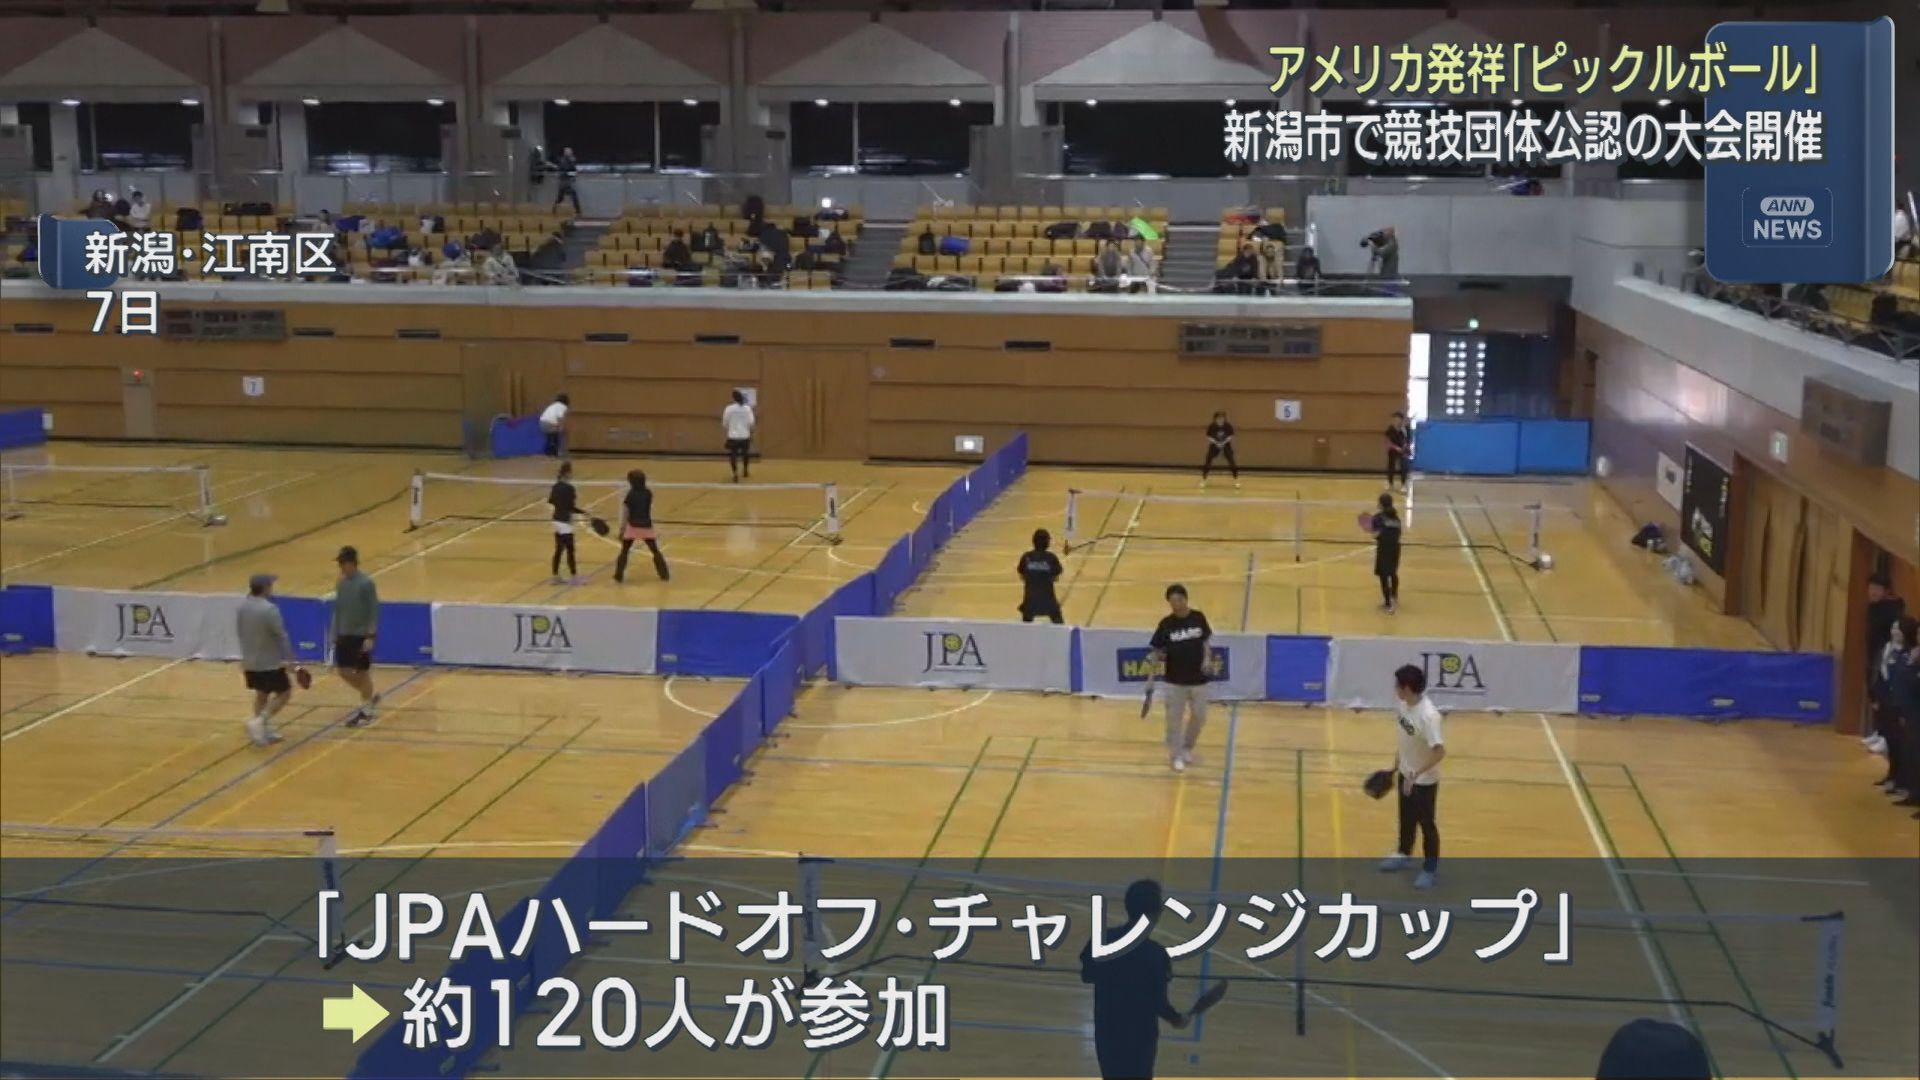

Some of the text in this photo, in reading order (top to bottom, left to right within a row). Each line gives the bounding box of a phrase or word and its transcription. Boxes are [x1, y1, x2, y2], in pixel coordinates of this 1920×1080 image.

[114, 603, 174, 641] JPA
[513, 613, 572, 652] JPA
[922, 632, 985, 673] JPA
[1420, 652, 1485, 688] JPA
